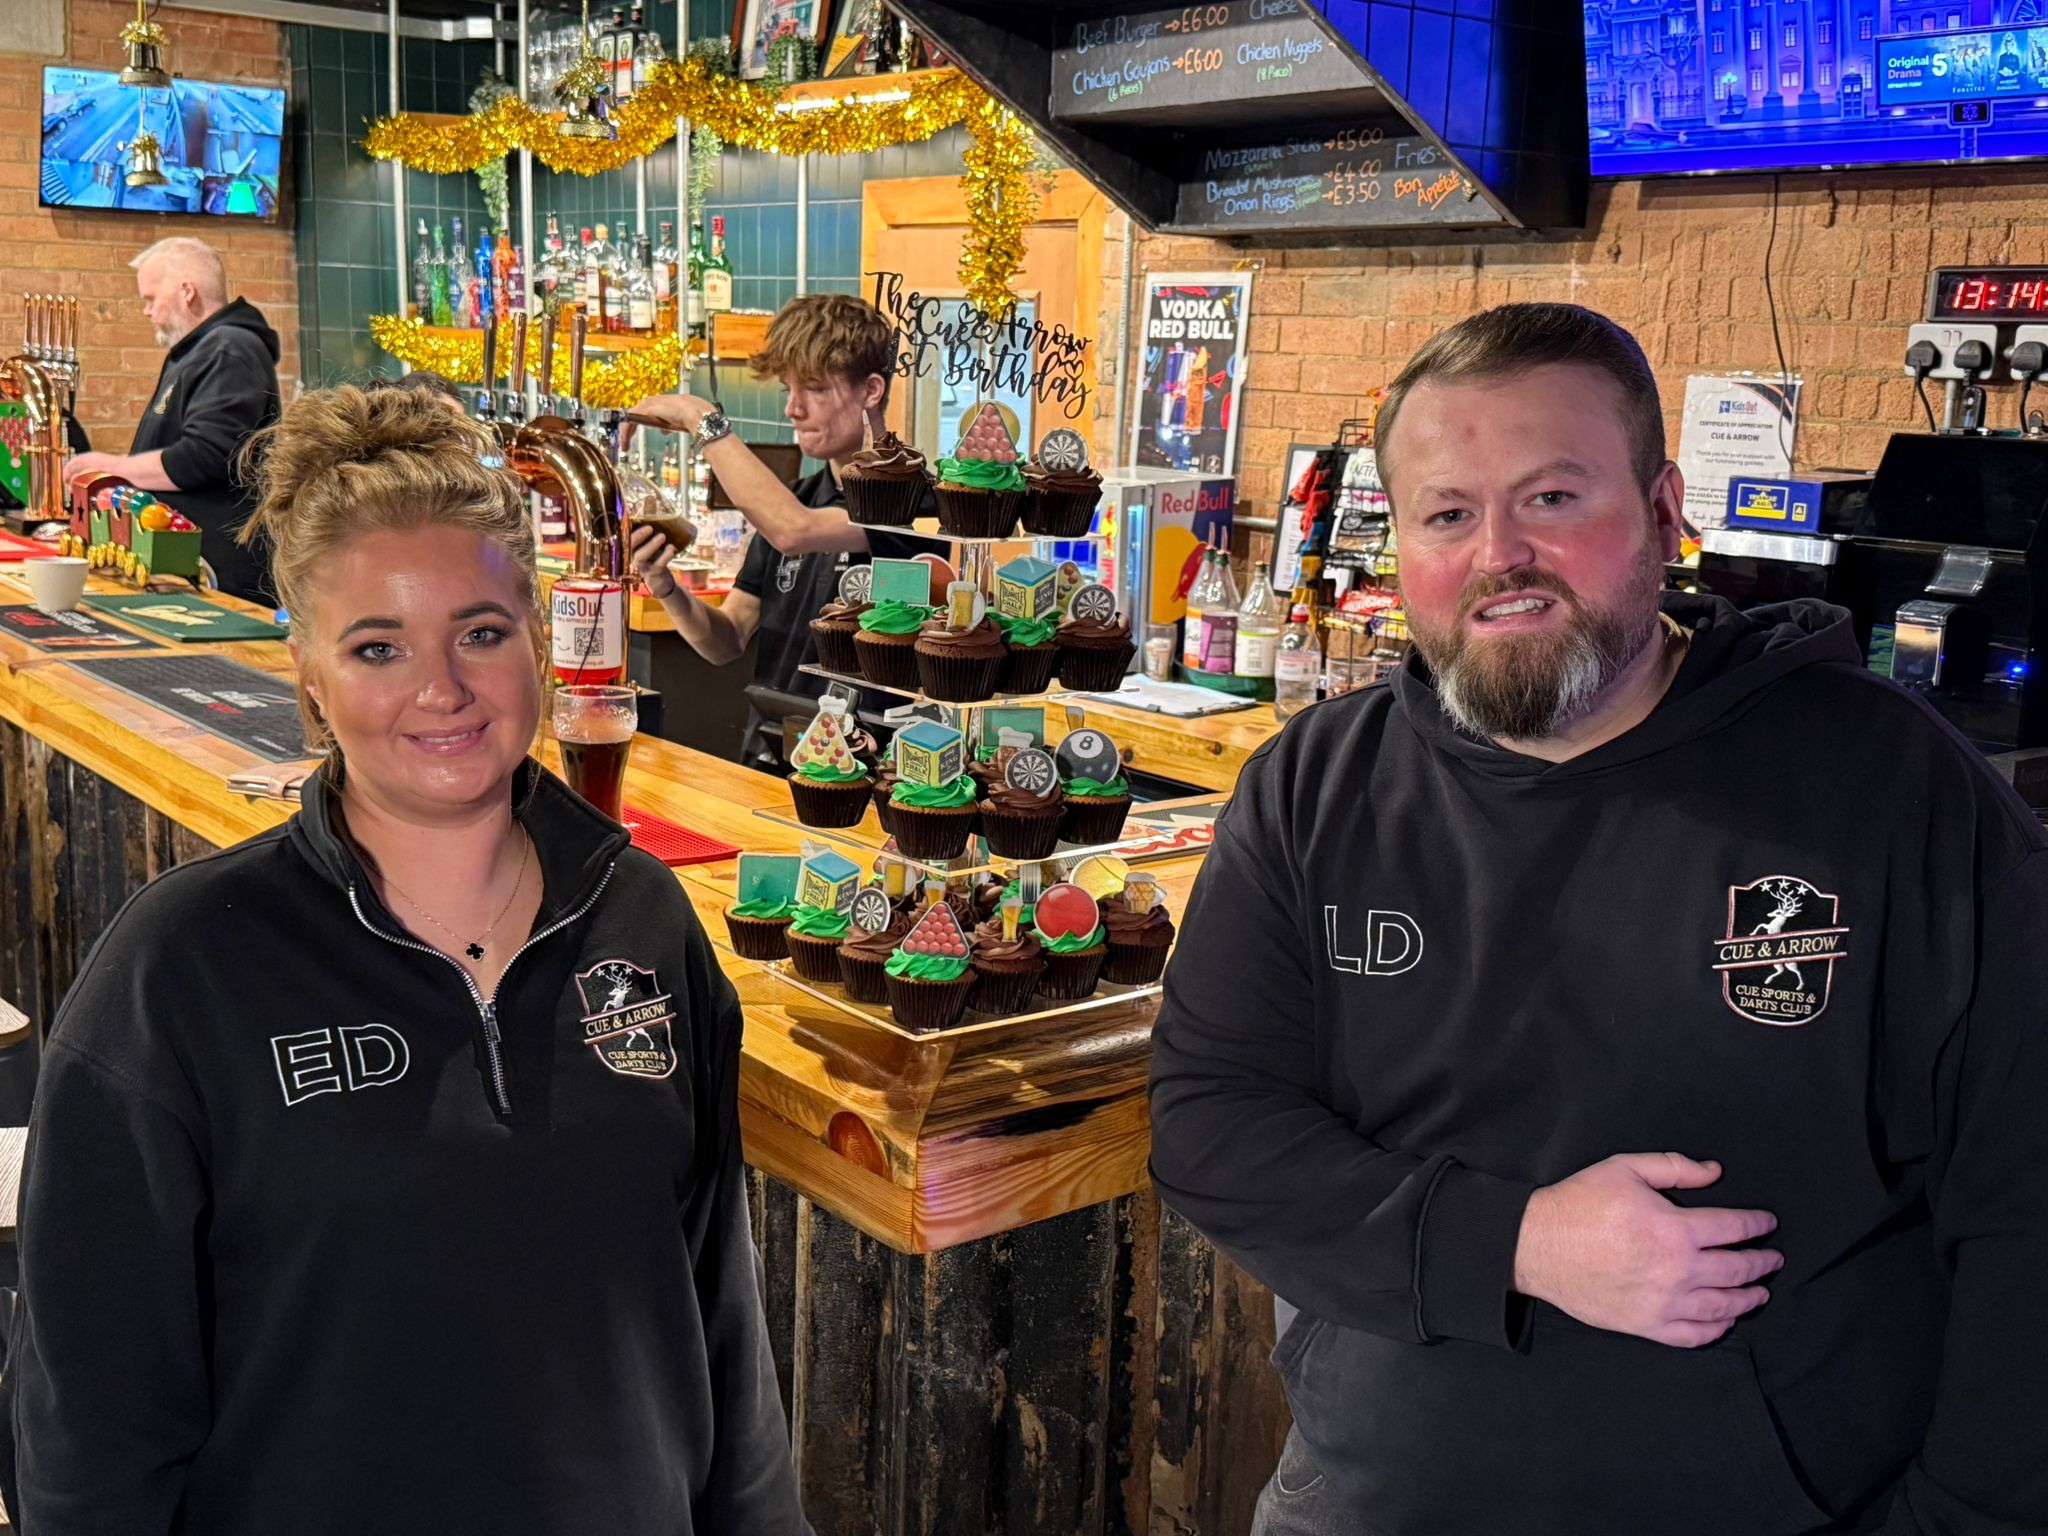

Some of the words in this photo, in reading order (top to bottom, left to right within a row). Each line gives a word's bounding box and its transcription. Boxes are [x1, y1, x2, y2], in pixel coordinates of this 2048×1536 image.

[1250, 0, 1298, 20] Cheese
[1077, 23, 1109, 54] Beef
[1114, 15, 1161, 49] Burger
[1237, 42, 1281, 64] Chicken
[1283, 37, 1323, 64] Nuggets
[1888, 55, 1930, 70] Original
[1888, 68, 1922, 79] Drama
[1931, 53, 1948, 77] 5
[1072, 67, 1120, 96] Chicken
[1123, 54, 1170, 82] Goujons
[1205, 147, 1283, 173] Mozzarella
[1395, 143, 1436, 169] Fries
[1394, 178, 1423, 200] Bon
[1223, 198, 1259, 216] Onion
[1262, 193, 1296, 214] Rings
[864, 271, 920, 319] The
[1160, 299, 1226, 320] VODKA
[914, 296, 971, 345] Cue
[993, 301, 1093, 353] Arrow
[1150, 319, 1185, 339] RED
[1187, 320, 1234, 340] BULL
[944, 342, 1092, 420] Birthday
[1732, 401, 1758, 413] KidsOut
[1711, 432, 1725, 440] CUE
[1733, 433, 1760, 441] ARROW
[1161, 489, 1195, 514] Red
[1198, 487, 1230, 512] Bull
[1080, 735, 1094, 750] 8
[1325, 905, 1423, 976] LD
[1720, 943, 1755, 961] CUE
[1758, 941, 1772, 957] &
[1776, 935, 1839, 956] ARROW
[1735, 984, 1760, 997] CUE
[1762, 988, 1804, 1003] SPORTS
[1806, 993, 1816, 1004] &
[1740, 996, 1778, 1011] DARTS
[1781, 1002, 1812, 1014] CLUB
[586, 1018, 611, 1036] CUE
[613, 1015, 623, 1028] &
[625, 1002, 667, 1025] ARROW
[270, 1023, 410, 1107] ED
[608, 1050, 627, 1060] CUE
[627, 1050, 659, 1060] SPORTS
[615, 1060, 644, 1069] DARTS
[646, 1060, 667, 1070] CLUB
